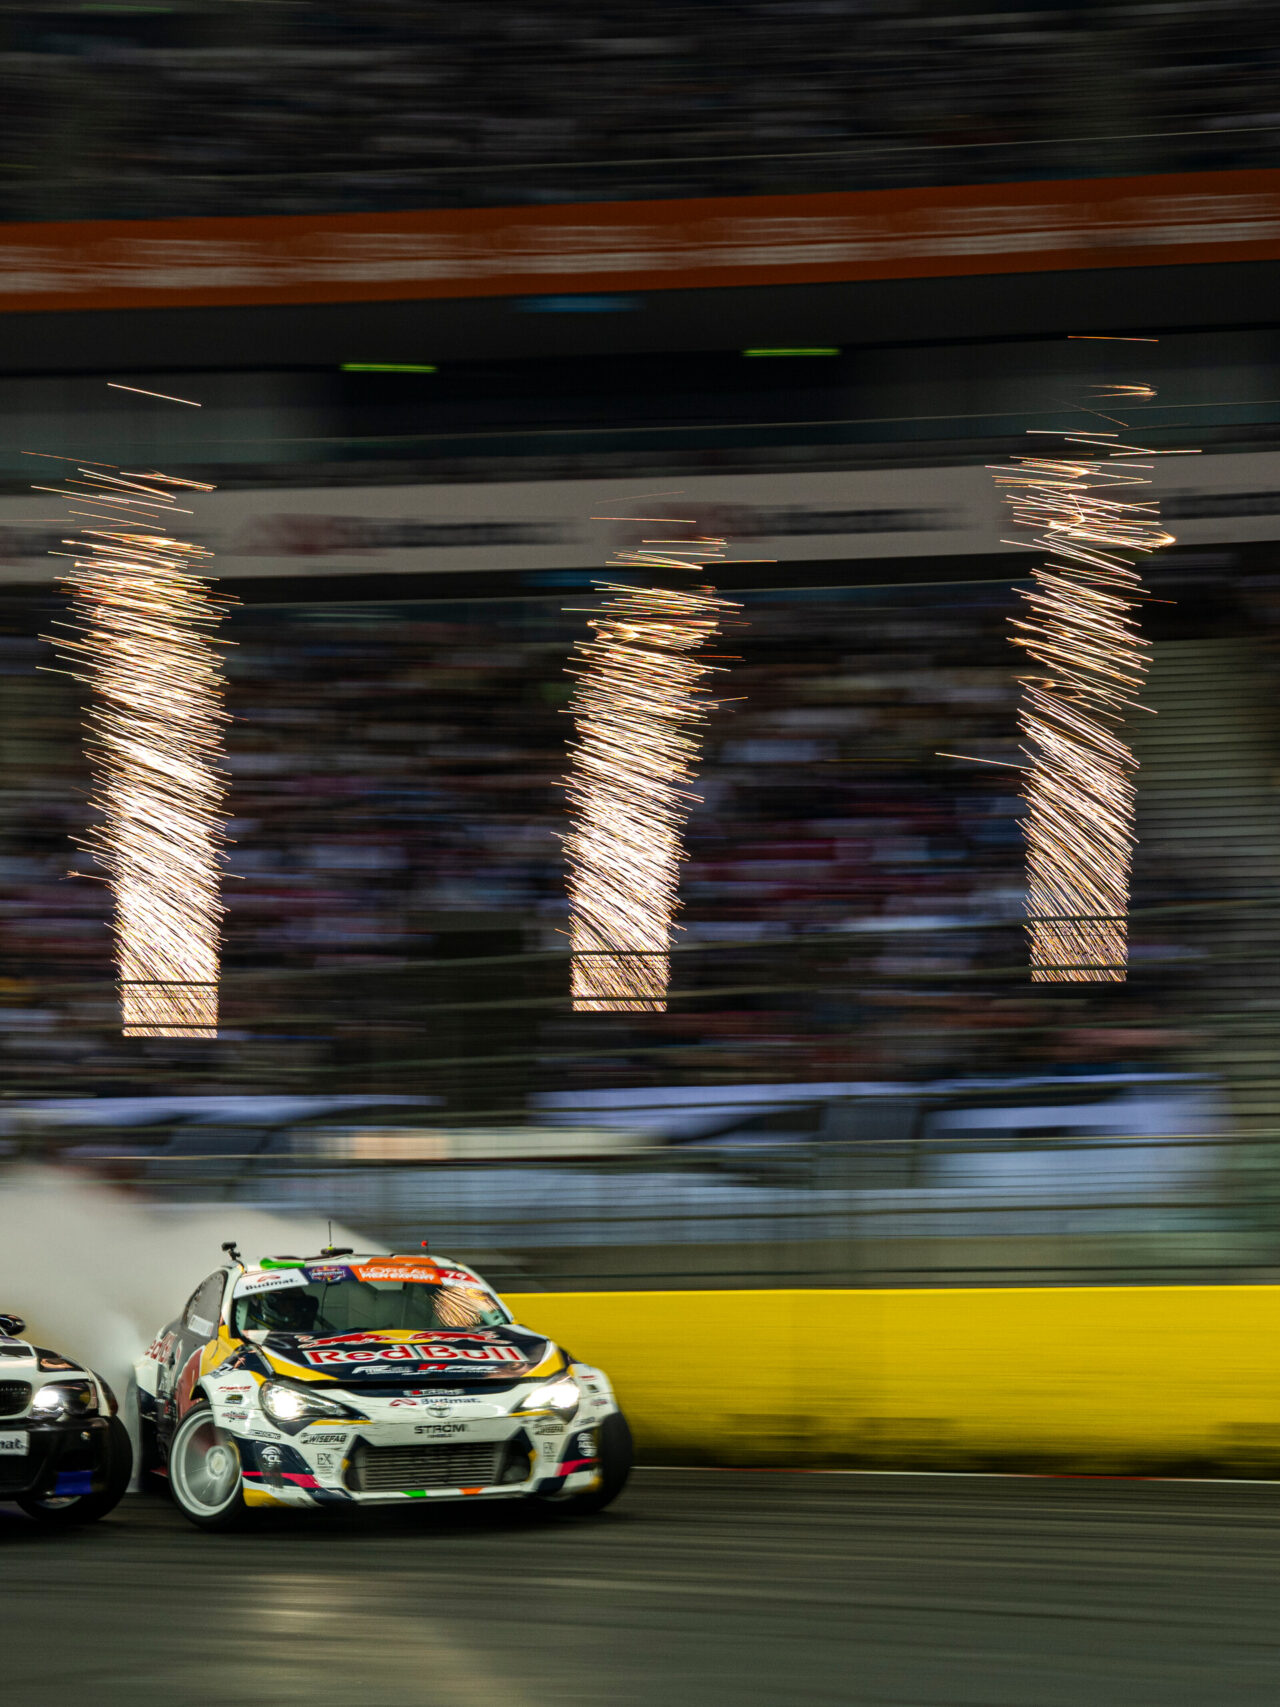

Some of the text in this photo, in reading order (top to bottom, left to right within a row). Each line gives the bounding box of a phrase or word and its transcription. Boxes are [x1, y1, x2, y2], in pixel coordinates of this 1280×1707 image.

[305, 1345, 526, 1363] Red Bull
[308, 1434, 347, 1444] WISEFAB
